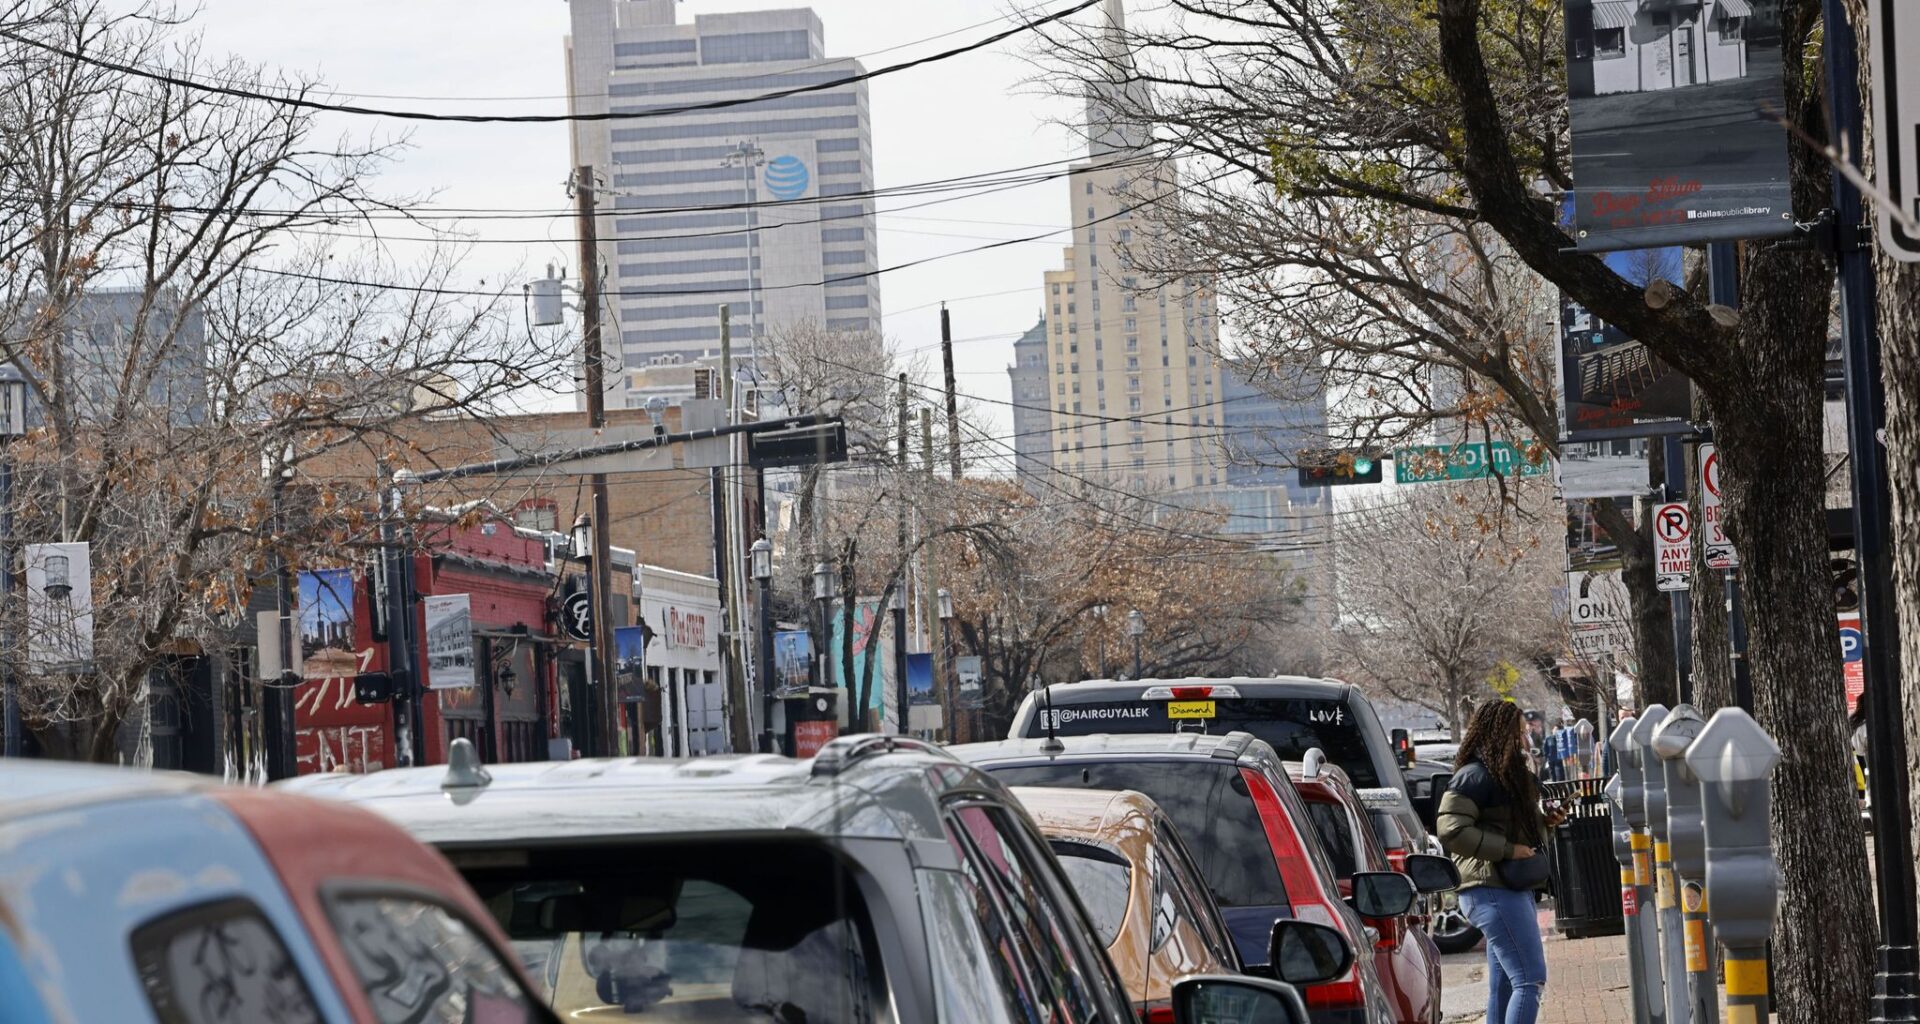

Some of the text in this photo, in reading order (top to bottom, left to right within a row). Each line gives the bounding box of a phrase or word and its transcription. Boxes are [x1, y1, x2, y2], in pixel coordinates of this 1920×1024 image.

[1696, 206, 1771, 219] dallaspubliclibrary
[1661, 547, 1690, 561] ANY
[1660, 560, 1691, 574] TIME
[1579, 602, 1621, 619] ONL
[1060, 707, 1150, 723] @HAIRGUYALEK
[1169, 701, 1213, 715] Diamond
